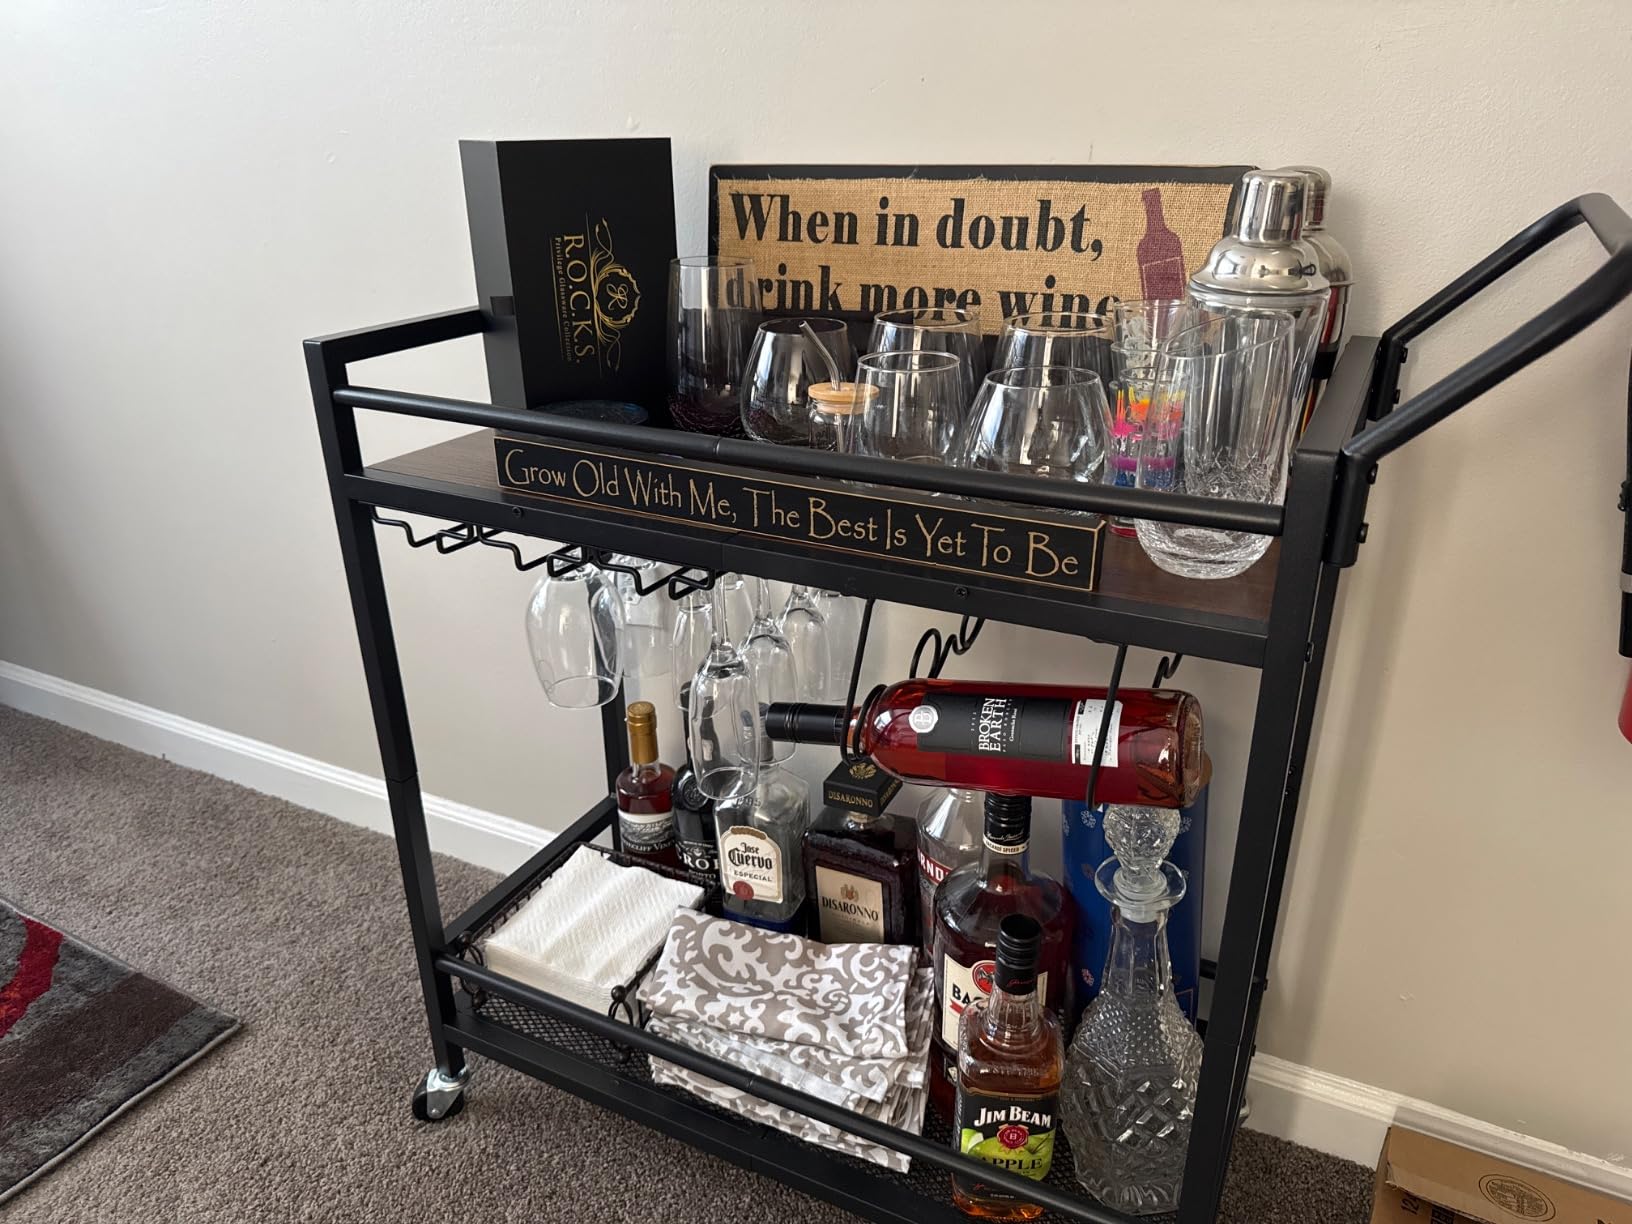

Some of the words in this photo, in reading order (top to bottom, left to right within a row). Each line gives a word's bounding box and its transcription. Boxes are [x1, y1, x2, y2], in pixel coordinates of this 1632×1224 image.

[729, 191, 859, 246] When
[875, 196, 919, 247] in
[936, 197, 1103, 261] doubt,
[860, 283, 982, 322] more
[505, 448, 566, 487] Grow
[573, 459, 619, 497] Old
[624, 466, 682, 508] With
[689, 478, 737, 524] Me,
[742, 486, 800, 528] The
[808, 497, 878, 542] Best
[885, 508, 907, 550] Is
[915, 513, 967, 557] Yet
[970, 522, 1011, 567] To
[1024, 531, 1079, 577] Be
[978, 697, 995, 751] BROKEN
[990, 698, 1007, 752] EARTH
[828, 790, 874, 808] DISARONNO
[728, 847, 773, 870] Cuervo
[740, 841, 760, 855] Jose
[733, 869, 773, 882] ESPECIAL
[821, 896, 880, 921] DISARONNO
[974, 1106, 1006, 1127] JIM
[1009, 1105, 1052, 1128] BEAM
